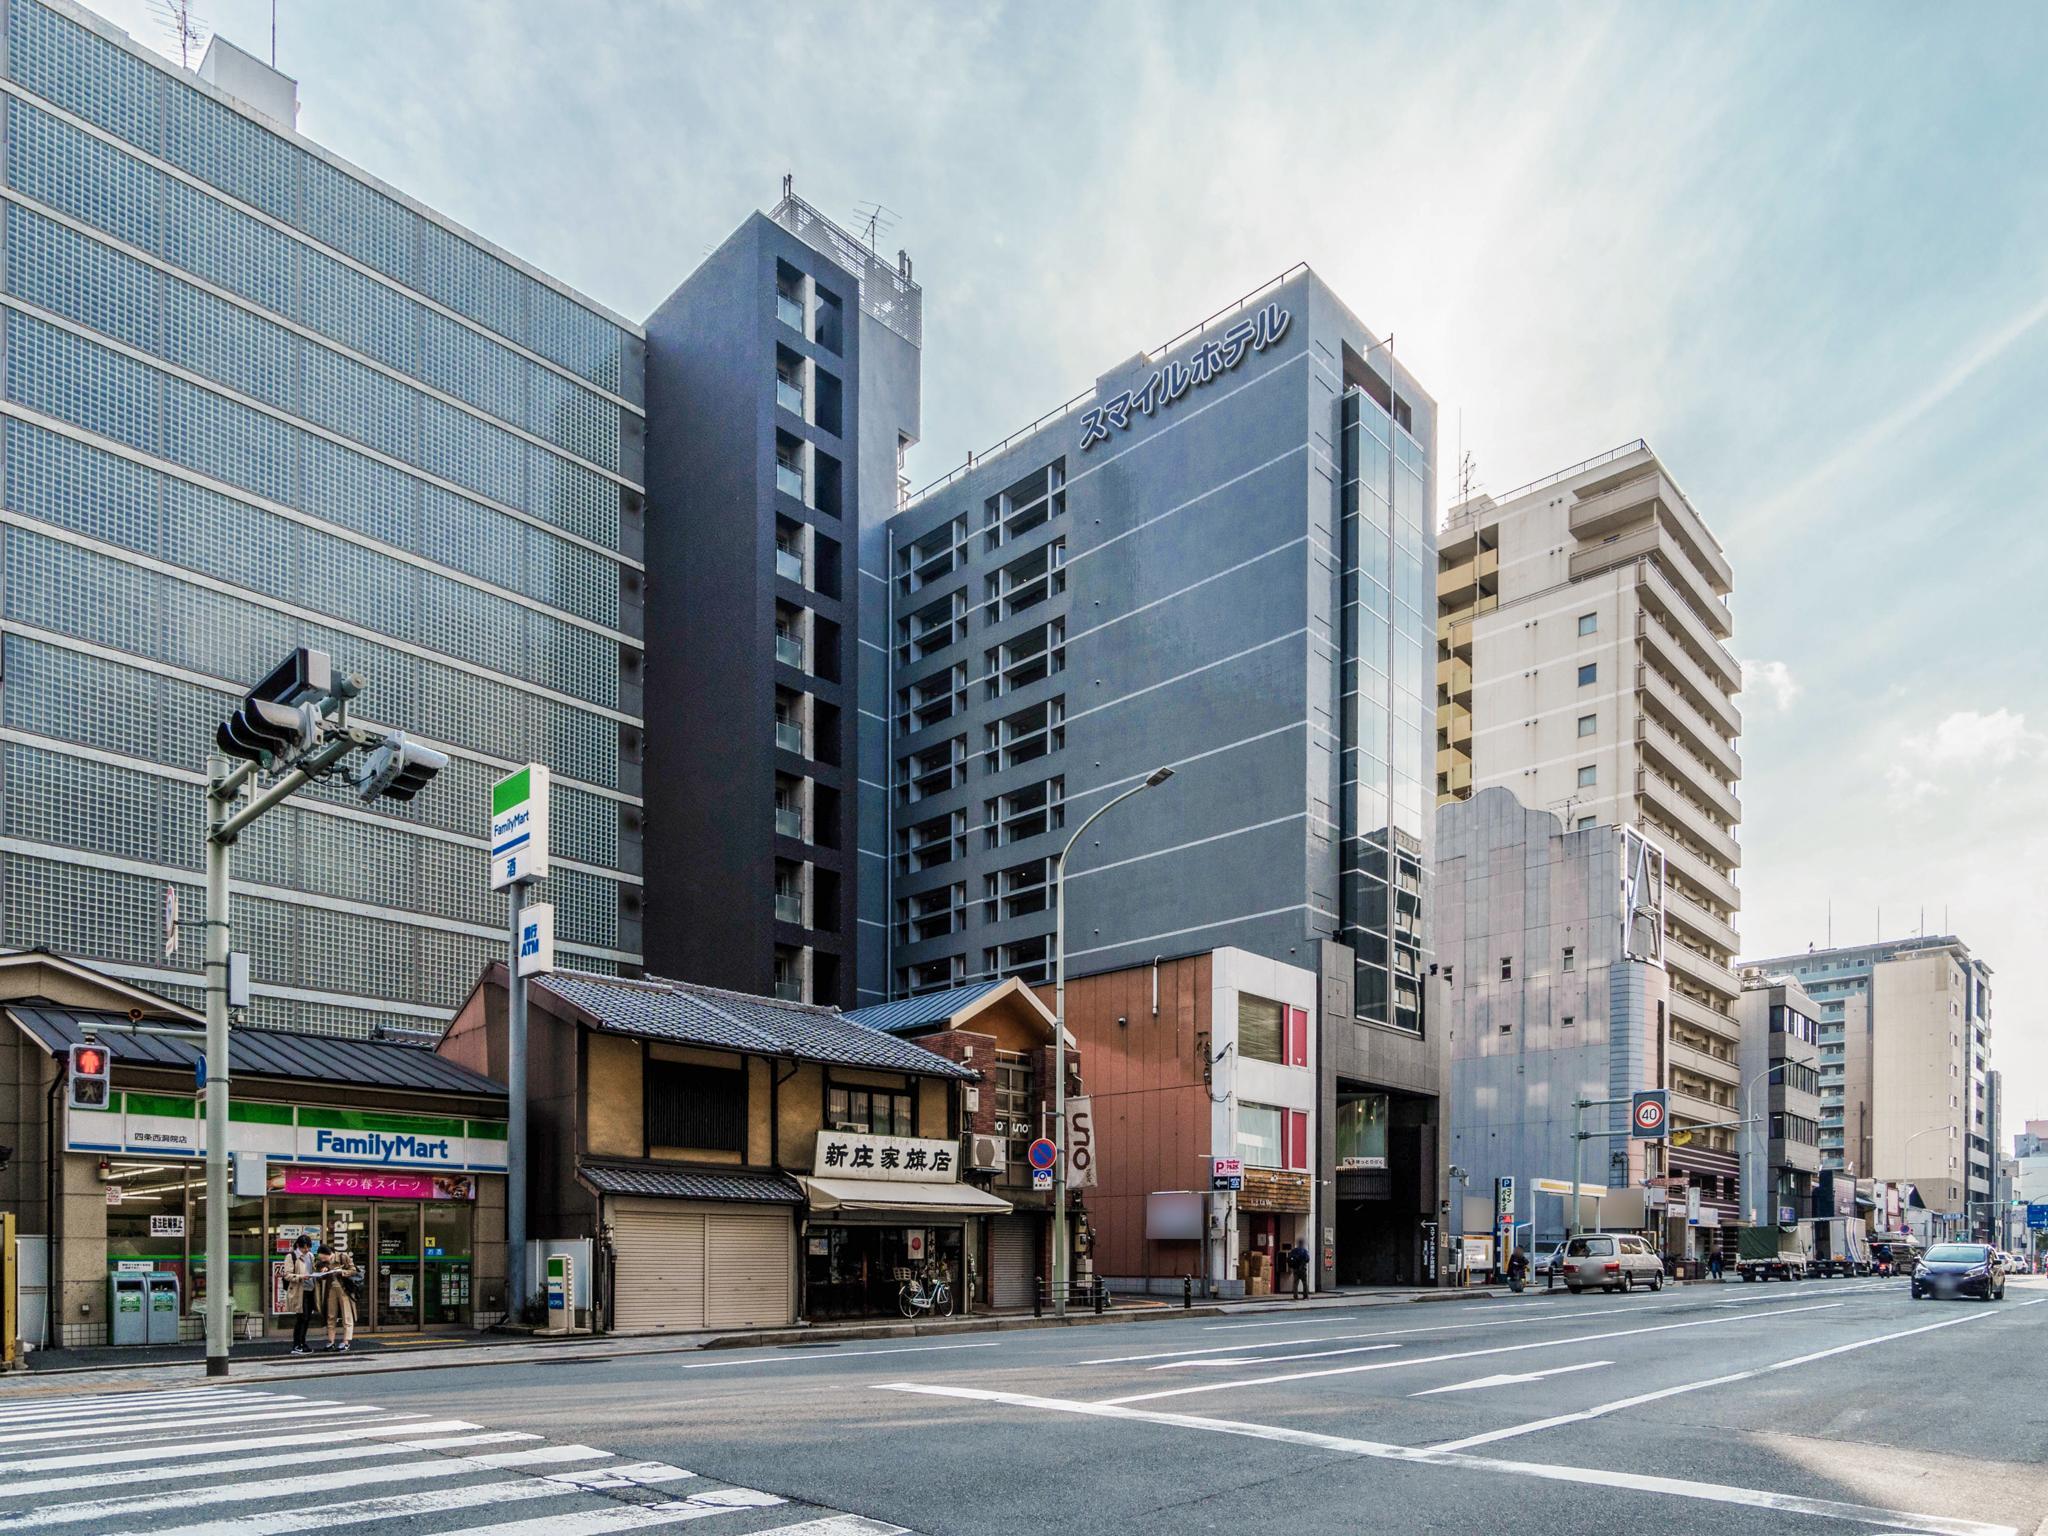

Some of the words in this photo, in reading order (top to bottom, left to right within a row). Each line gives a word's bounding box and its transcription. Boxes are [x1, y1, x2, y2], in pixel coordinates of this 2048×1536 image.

[1079, 302, 1291, 450] スマイルホテル
[493, 809, 529, 838] FamilyMart
[507, 856, 516, 877] 酒
[521, 938, 539, 958] ATM
[1641, 1108, 1657, 1121] 40
[1012, 1122, 1029, 1134] uno
[316, 1129, 449, 1162] FamilyMart
[1072, 1112, 1090, 1170] uno
[824, 1142, 952, 1172] 新庄家旗店
[1216, 1161, 1224, 1173] P
[299, 1175, 421, 1192] ファミマの春スイーツ
[1504, 1179, 1510, 1187] P
